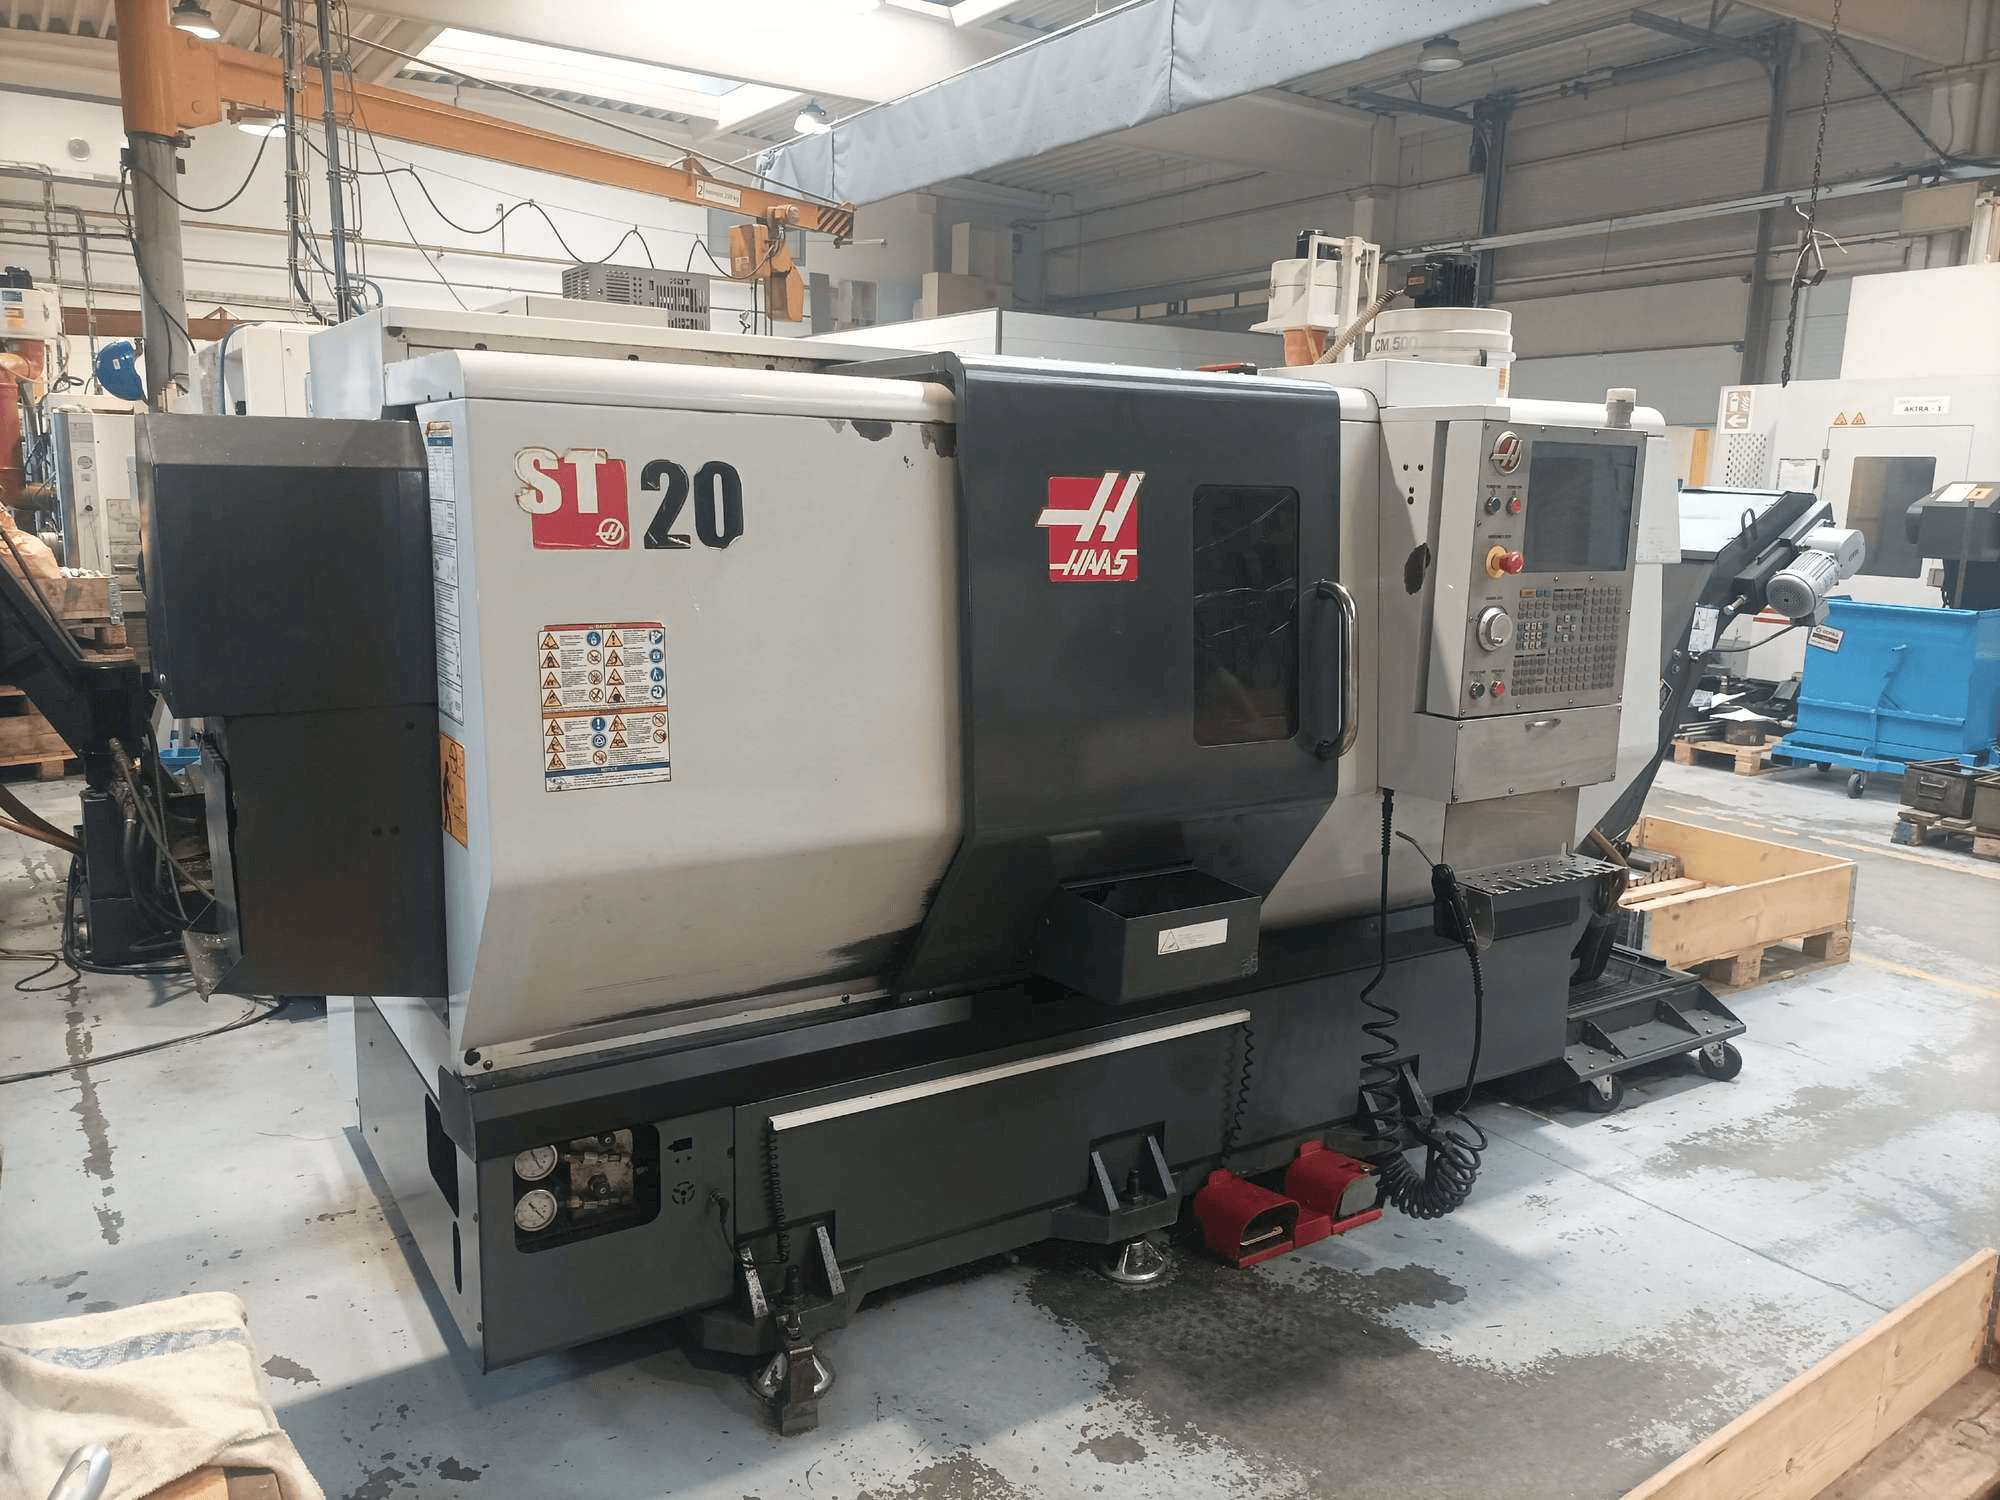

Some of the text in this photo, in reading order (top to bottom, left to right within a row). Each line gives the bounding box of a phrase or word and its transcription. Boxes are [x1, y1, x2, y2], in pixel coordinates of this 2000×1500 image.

[697, 184, 703, 196] 2
[1374, 337, 1390, 352] CM
[513, 446, 744, 551] ST 20
[1049, 548, 1137, 576] HAAS
